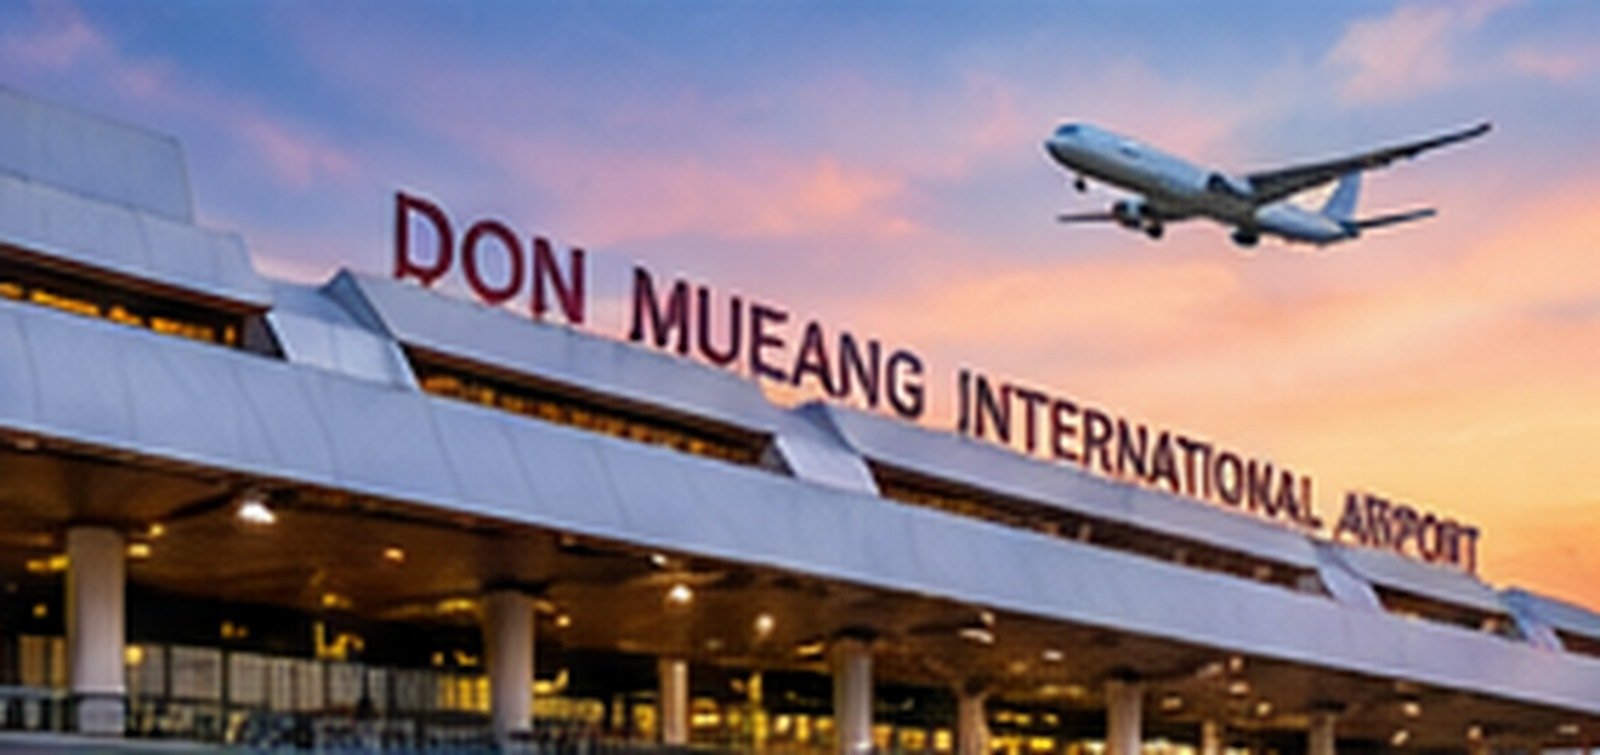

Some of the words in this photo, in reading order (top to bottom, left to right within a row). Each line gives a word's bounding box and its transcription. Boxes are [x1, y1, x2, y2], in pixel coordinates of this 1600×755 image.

[395, 191, 585, 325] DON
[630, 267, 924, 419] MUEANG
[958, 370, 1322, 528] INTERNATIONAL
